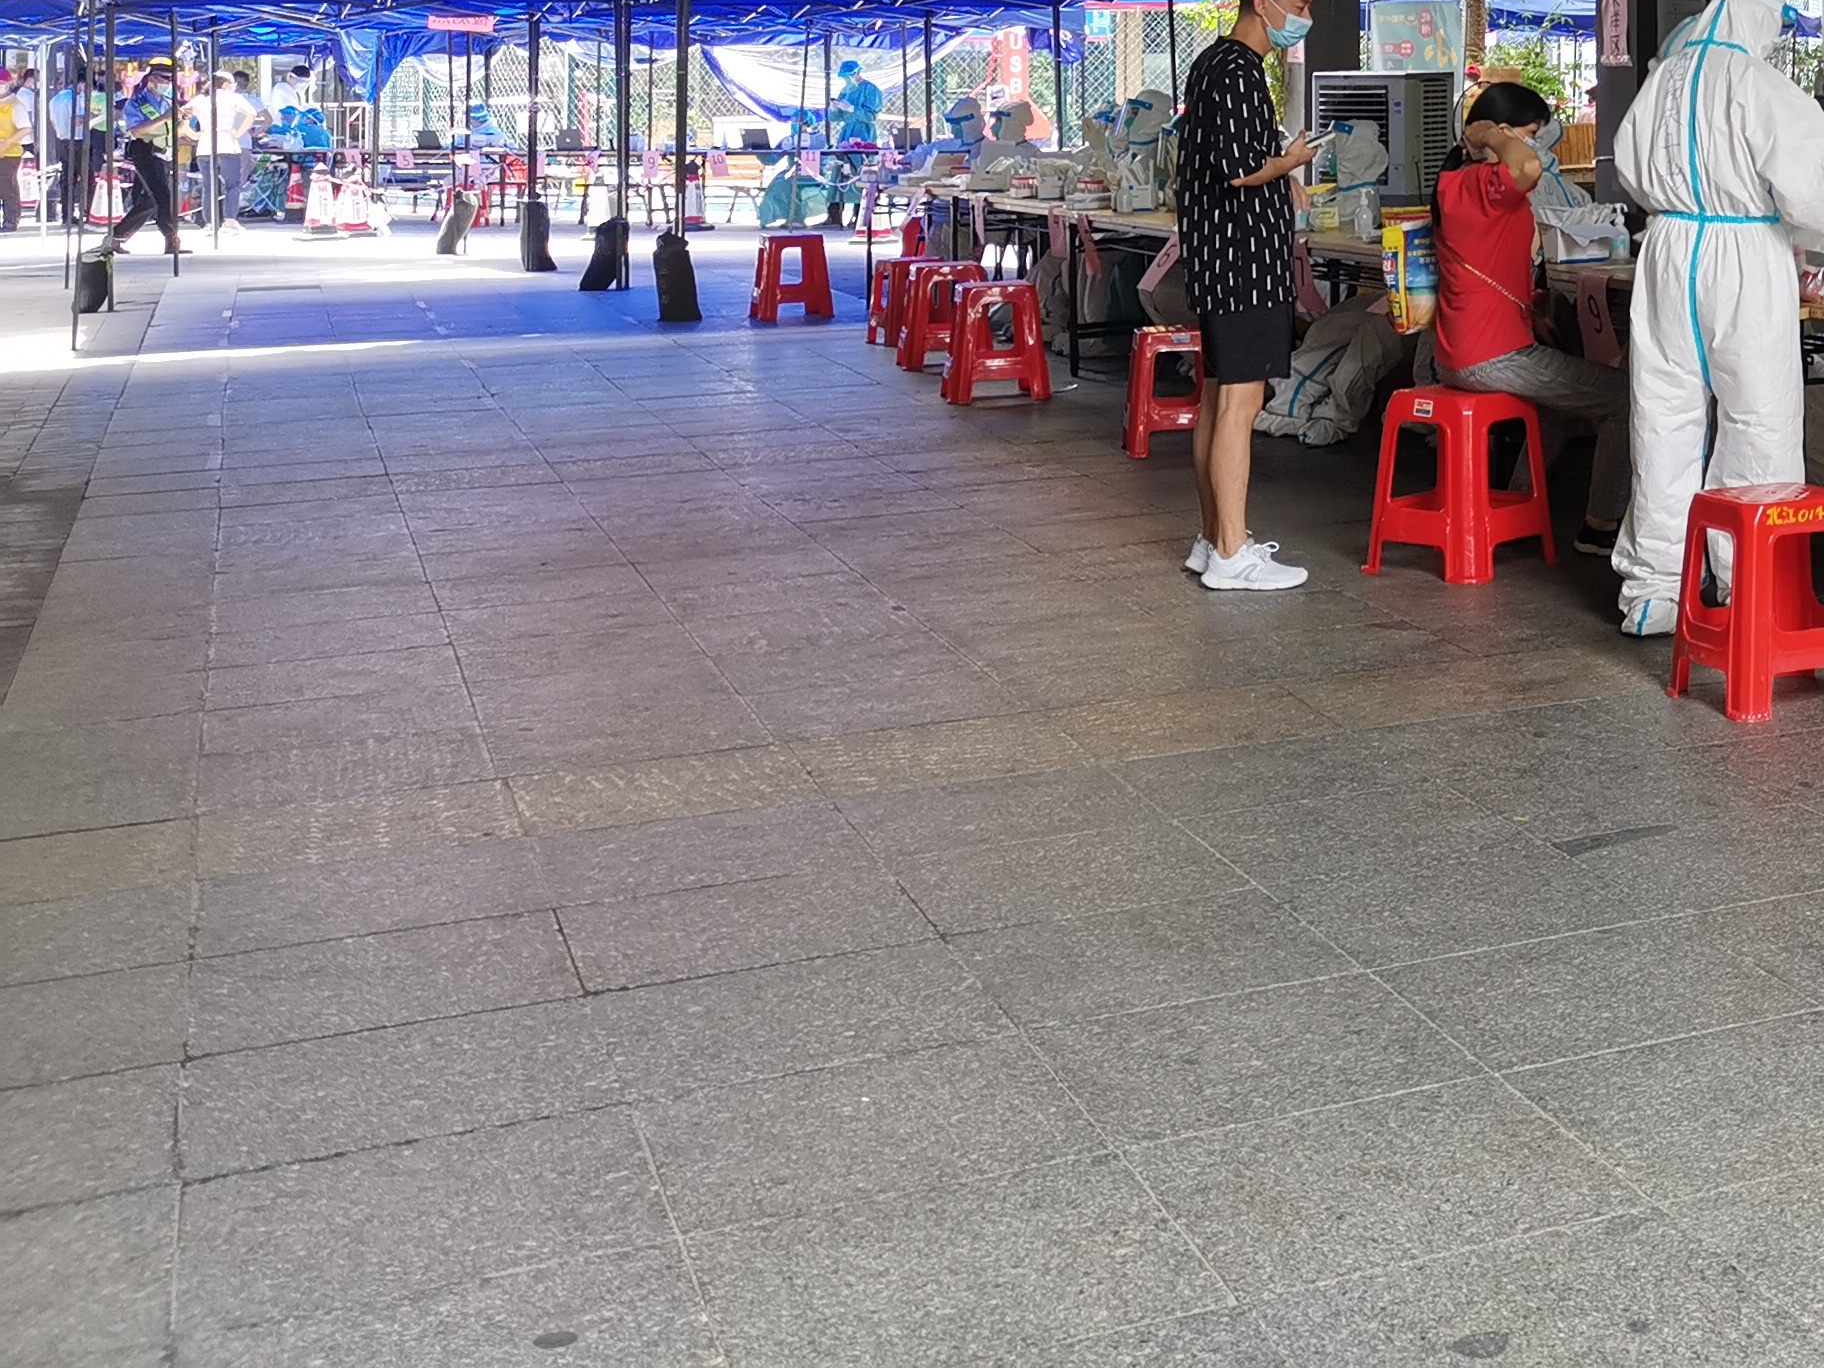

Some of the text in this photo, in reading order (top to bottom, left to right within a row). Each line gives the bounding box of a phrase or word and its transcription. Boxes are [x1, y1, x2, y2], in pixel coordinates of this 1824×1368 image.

[1009, 33, 1023, 94] USB
[647, 156, 656, 169] 9
[711, 154, 724, 165] 10
[805, 150, 817, 162] 11
[1156, 244, 1178, 269] 6
[1587, 299, 1603, 334] 9
